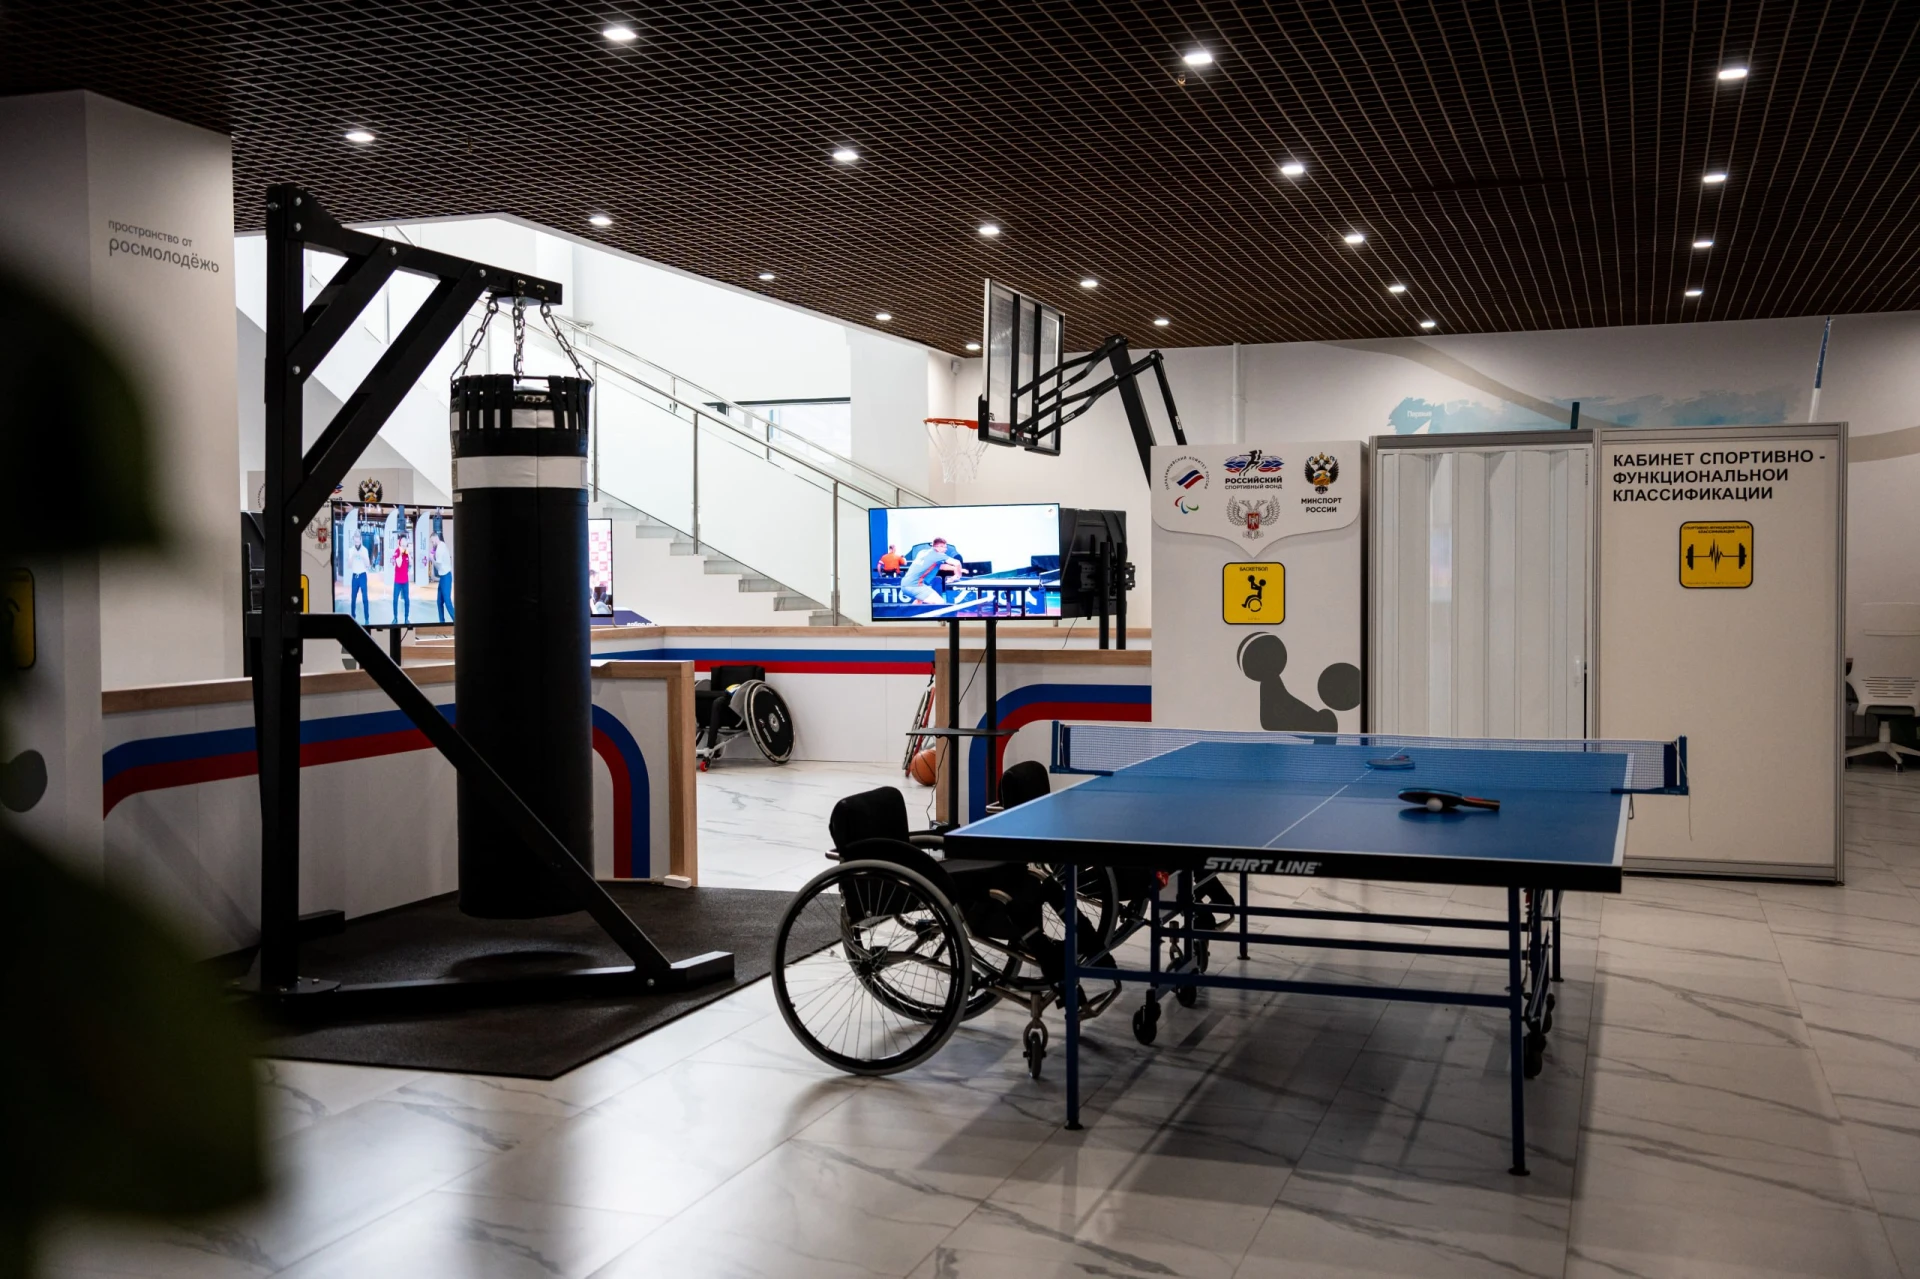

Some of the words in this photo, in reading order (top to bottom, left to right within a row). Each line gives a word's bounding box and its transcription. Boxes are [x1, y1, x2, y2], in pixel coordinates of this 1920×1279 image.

[108, 219, 179, 245] пространство
[182, 237, 193, 248] от
[109, 237, 220, 274] росмолодёжь
[1613, 453, 1695, 467] КАБИНЕТ
[1699, 450, 1814, 465] СПОРТИВНО
[1225, 475, 1283, 484] РОССИЙСКИЙ
[1613, 487, 1773, 502] КЛАССИФИКАЦИИ
[1204, 857, 1273, 872] START
